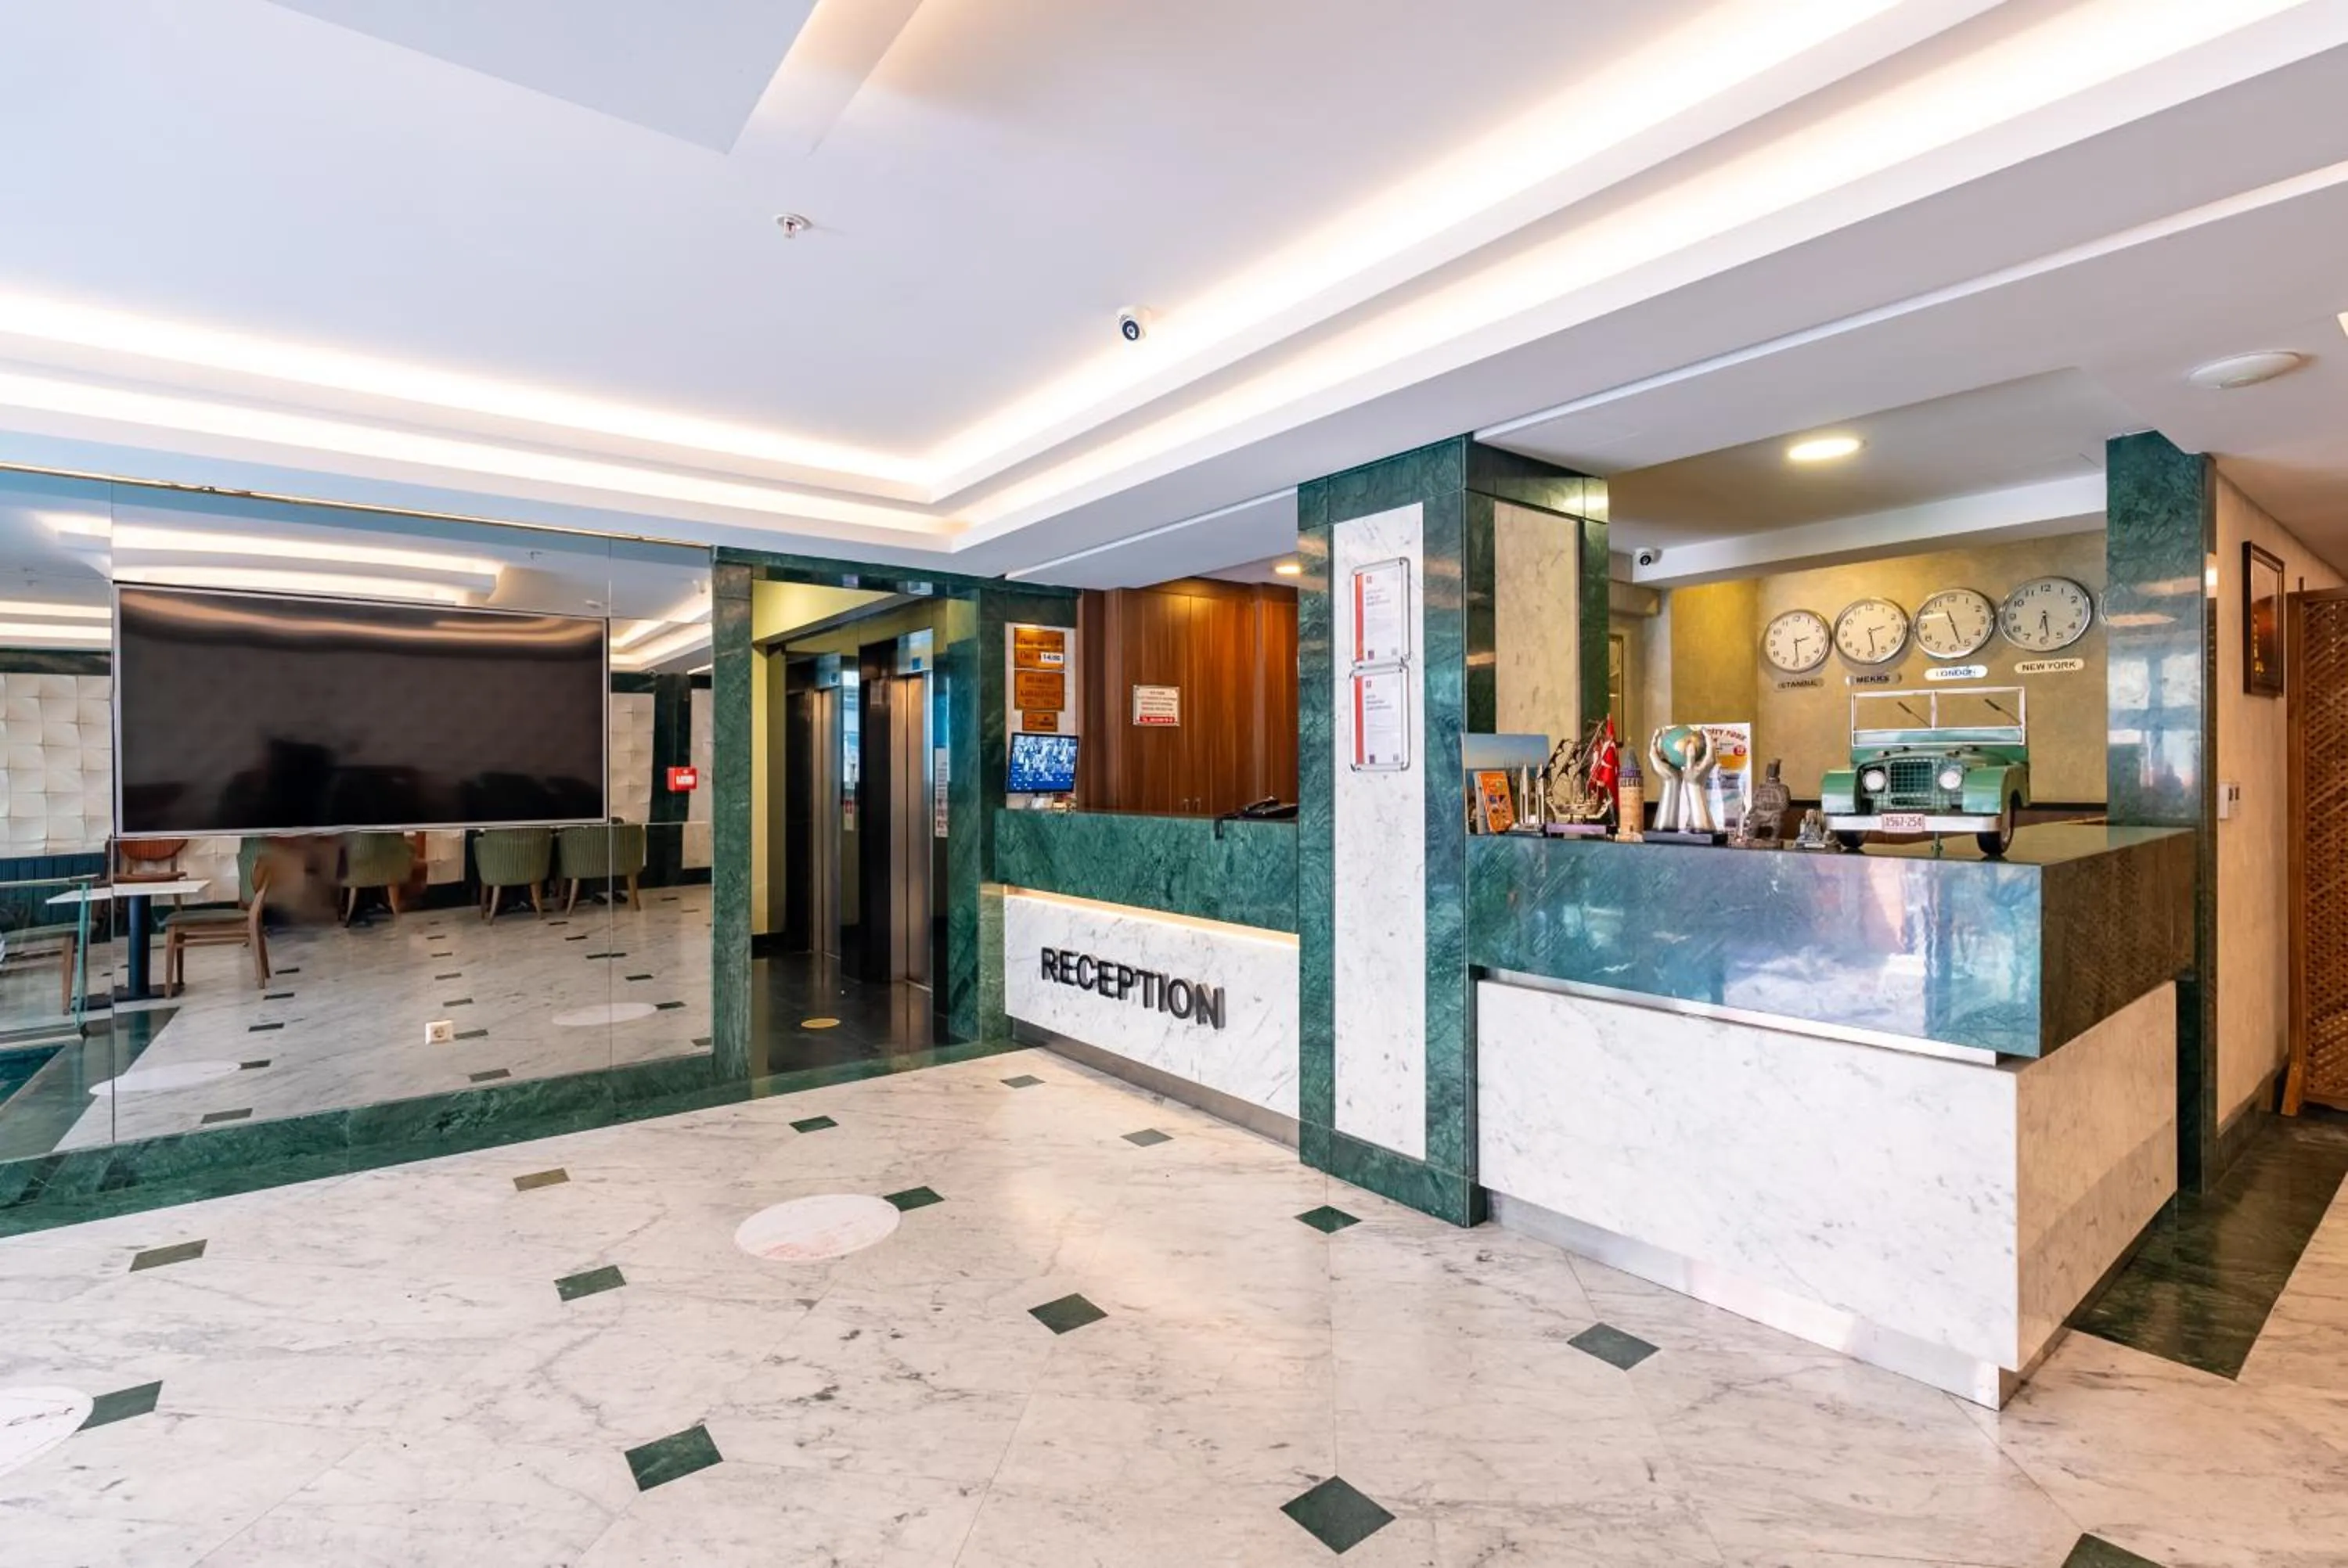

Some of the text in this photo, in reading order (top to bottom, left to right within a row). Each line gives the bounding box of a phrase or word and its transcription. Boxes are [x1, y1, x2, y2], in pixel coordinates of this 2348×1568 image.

[2022, 660, 2076, 672] NEW YORK
[1936, 667, 1976, 678] LONDON
[1041, 946, 1227, 1030] RECEPTION
